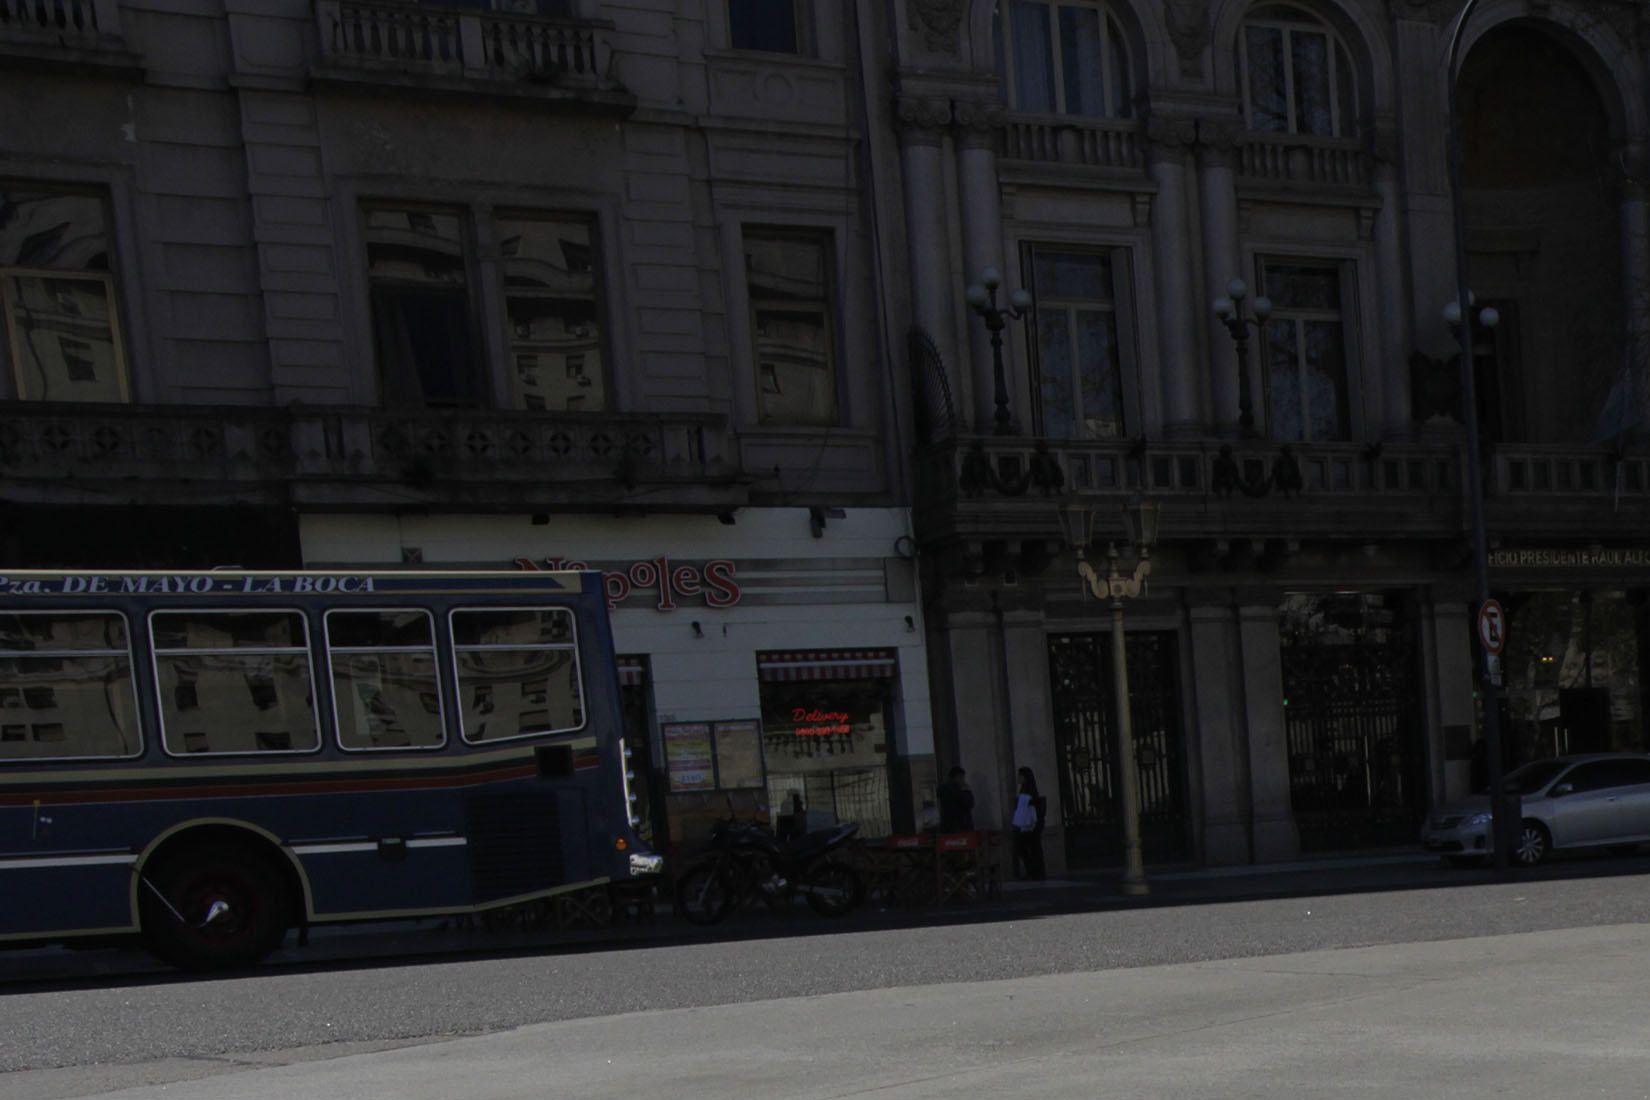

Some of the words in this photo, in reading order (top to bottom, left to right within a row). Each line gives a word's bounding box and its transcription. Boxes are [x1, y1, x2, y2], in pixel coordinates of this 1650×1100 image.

[1520, 551, 1590, 565] PRESIDENTE
[62, 575, 110, 594] DE
[120, 575, 215, 594] MAYO
[242, 575, 283, 593] LA
[293, 575, 376, 593] BOCA
